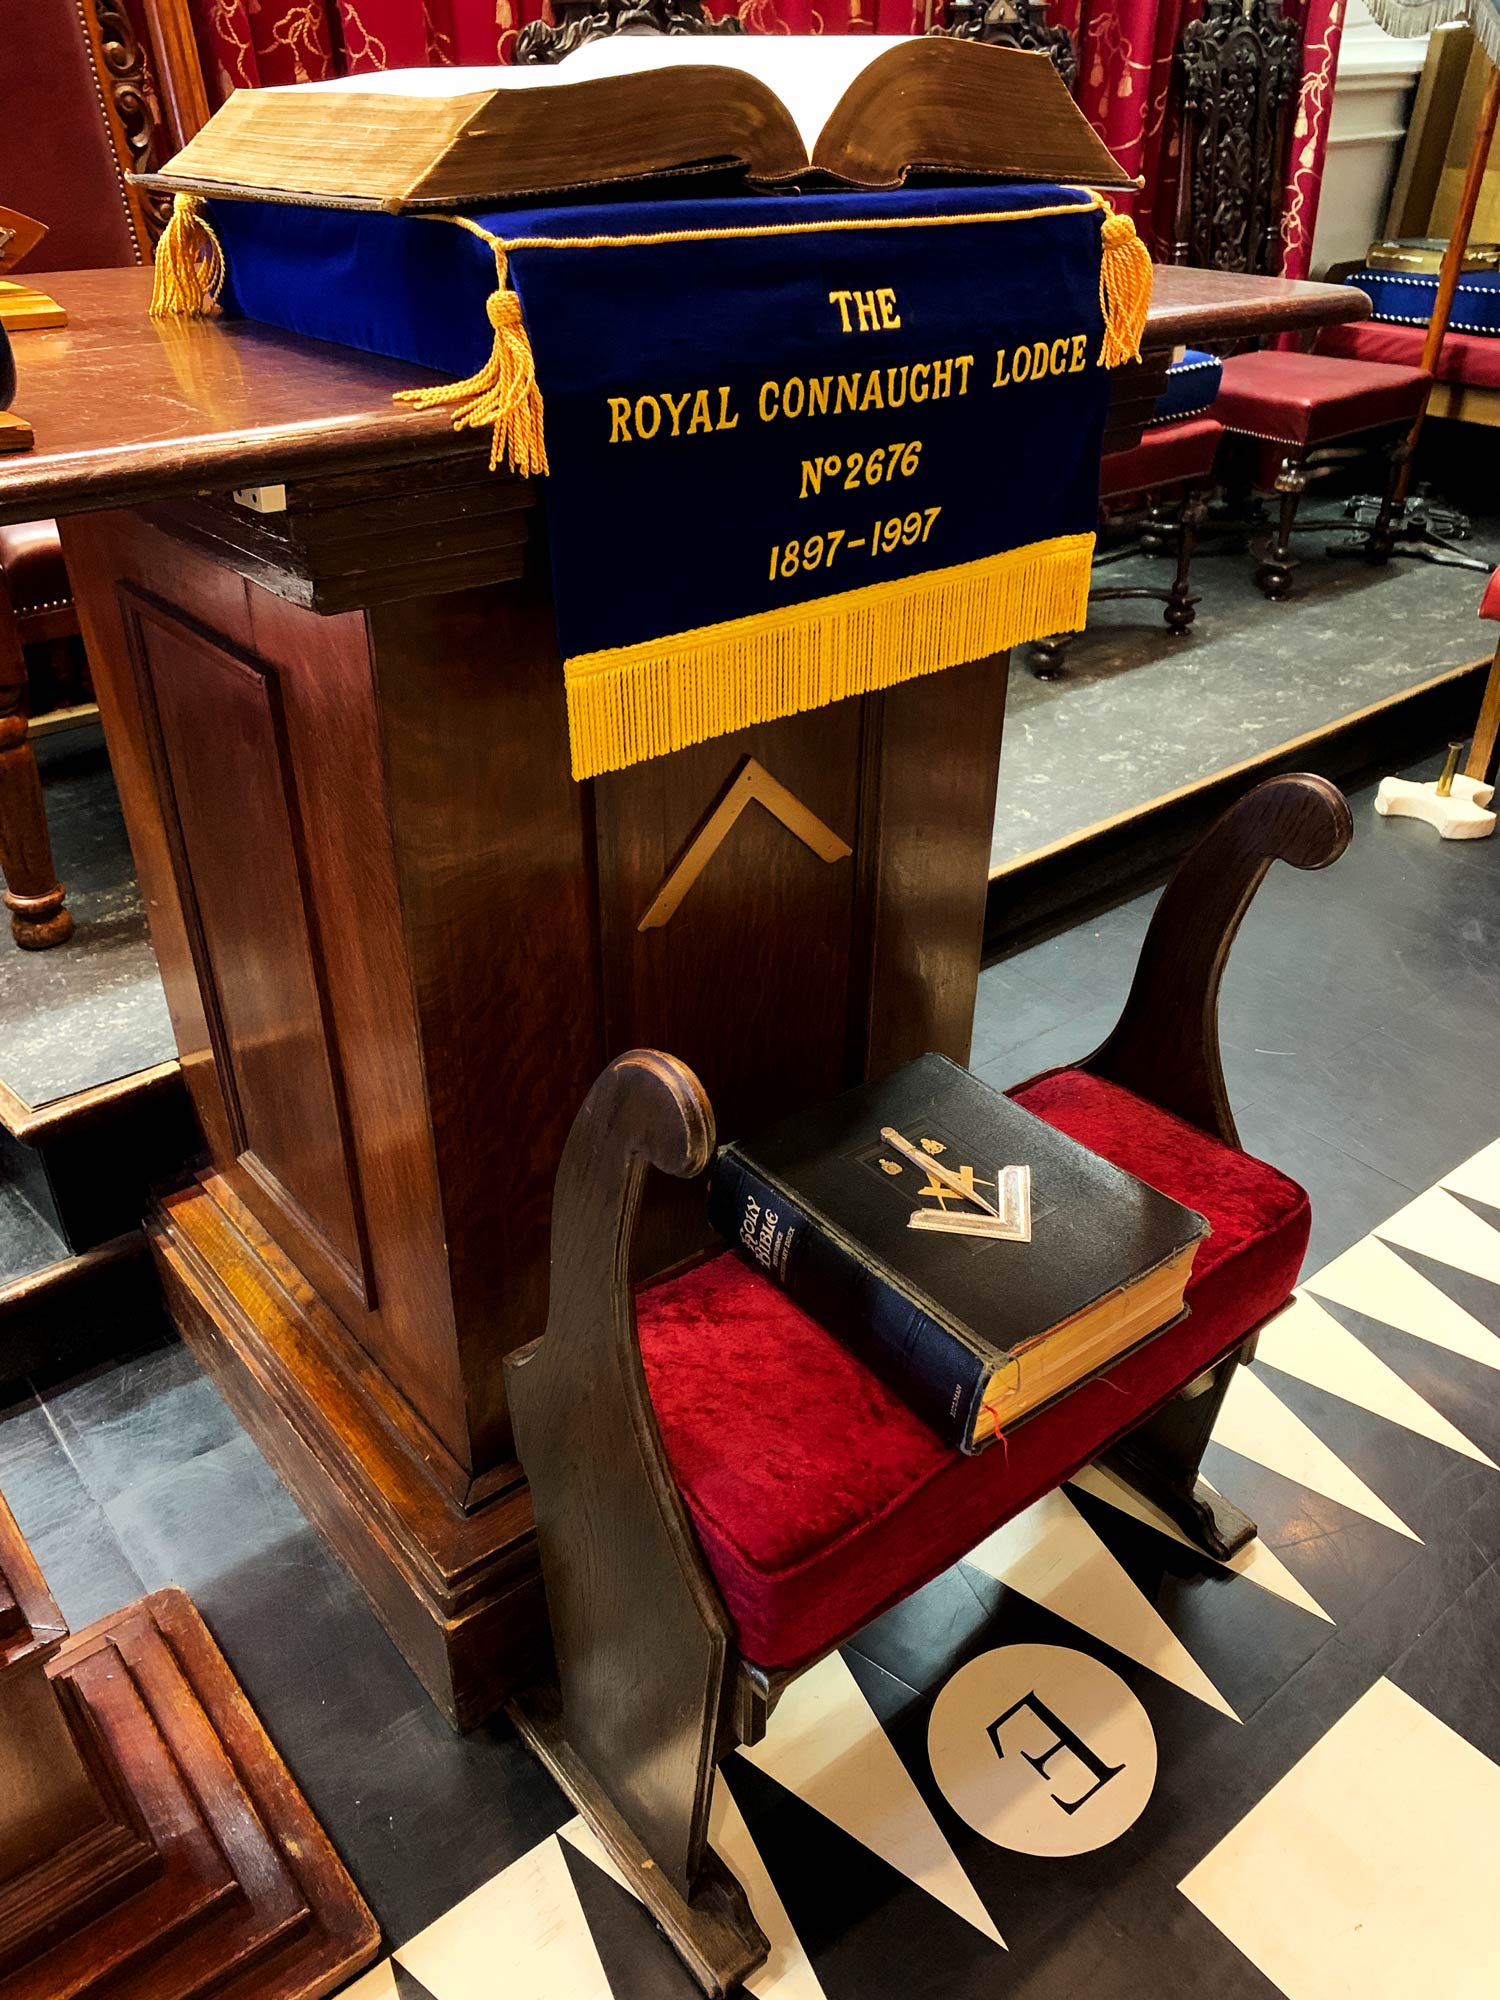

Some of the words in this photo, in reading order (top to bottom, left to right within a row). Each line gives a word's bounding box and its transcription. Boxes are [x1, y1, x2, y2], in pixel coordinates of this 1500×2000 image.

[829, 288, 902, 333] THE
[607, 386, 739, 443] ROYAL
[759, 355, 975, 422] CONNAUGHT
[992, 334, 1088, 388] LODGE
[768, 506, 942, 582] 1897-1997
[740, 1195, 761, 1252] HOLY
[754, 1208, 779, 1270] BIBLE
[986, 1690, 1126, 1816] E
